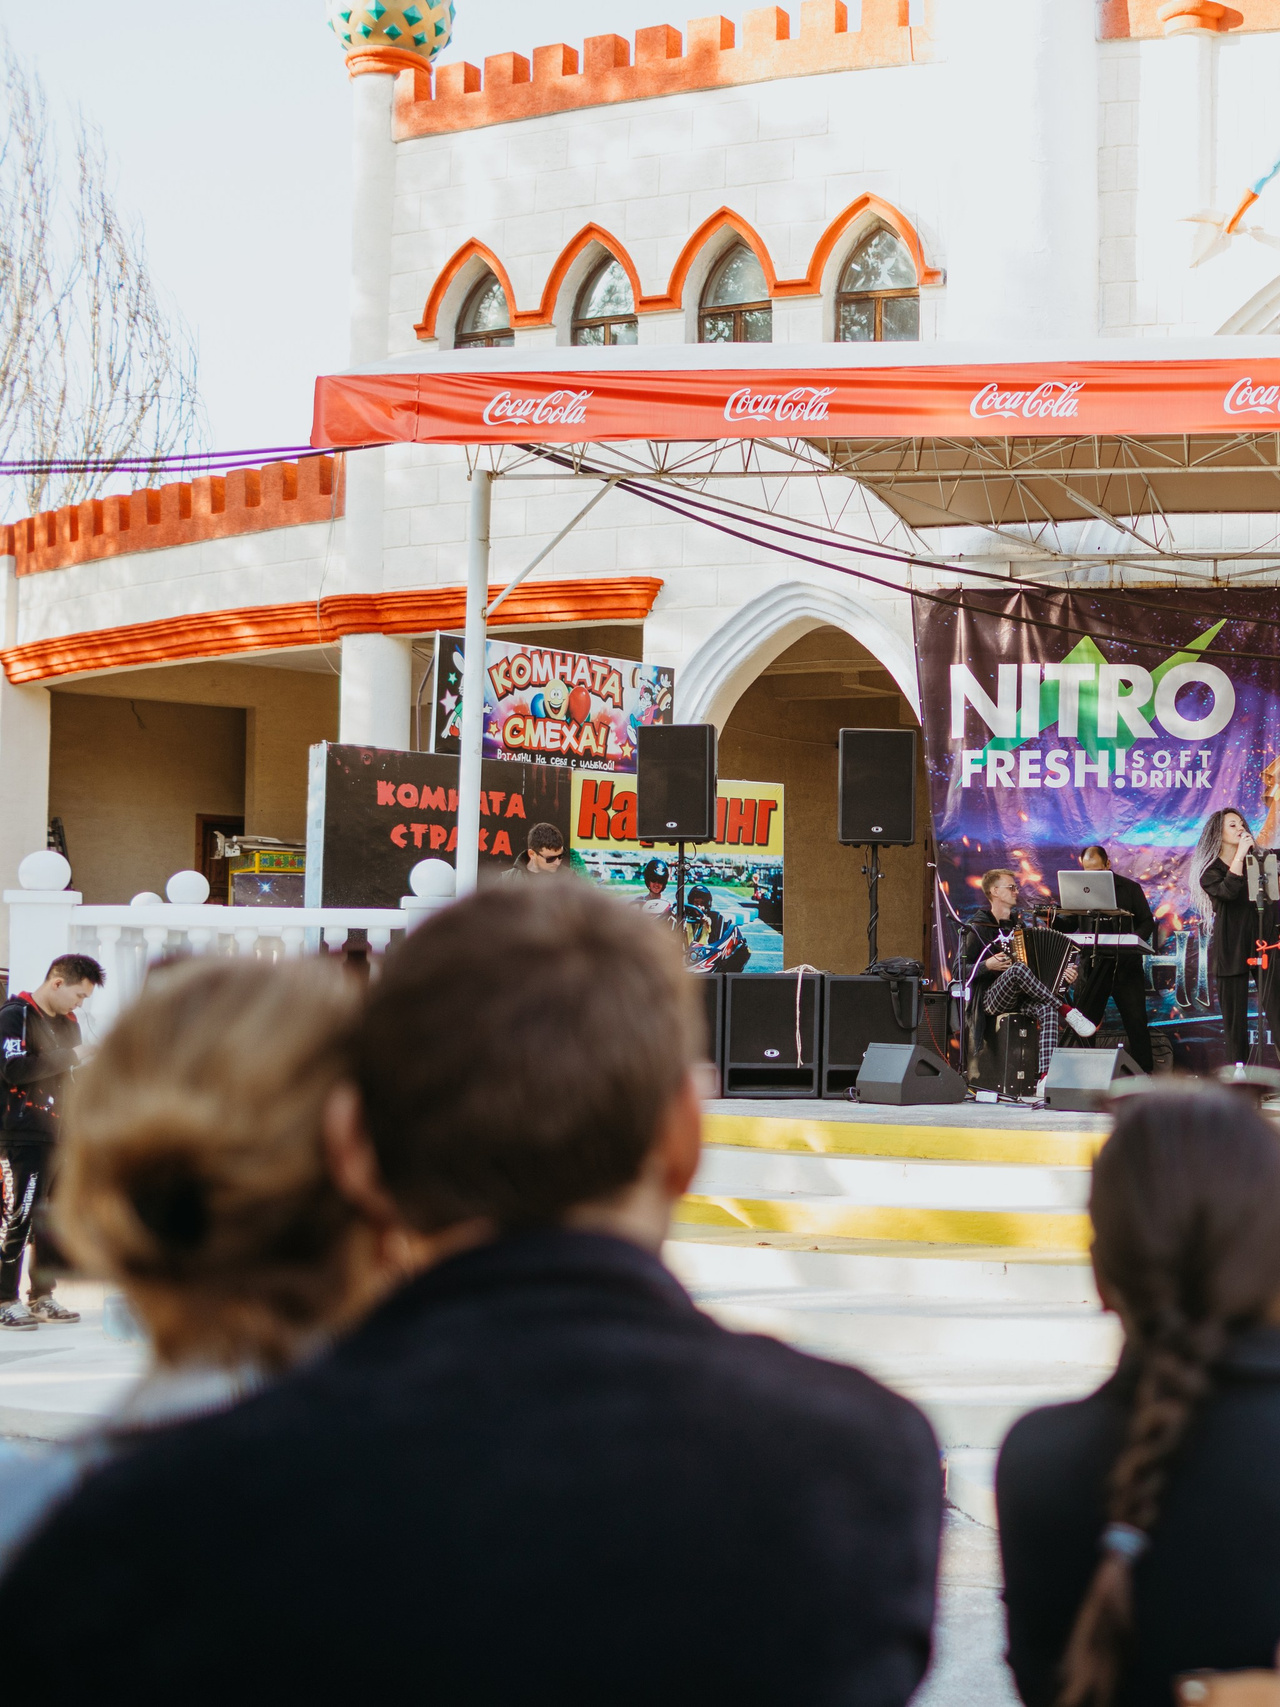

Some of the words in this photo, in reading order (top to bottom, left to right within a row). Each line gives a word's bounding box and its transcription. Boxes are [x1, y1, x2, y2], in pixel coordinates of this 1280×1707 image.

[483, 389, 594, 426] Coca-Cola
[724, 387, 838, 422] Coca-Cola
[969, 381, 1086, 419] Coca-Cola
[488, 650, 624, 710] КОМНАТА
[950, 662, 1236, 740] NITRO
[502, 714, 611, 757] СМЕХА!
[962, 749, 1126, 789] FRESH!
[1131, 750, 1212, 768] SOFT
[1131, 770, 1212, 788] DRINK
[577, 779, 777, 847] Канг
